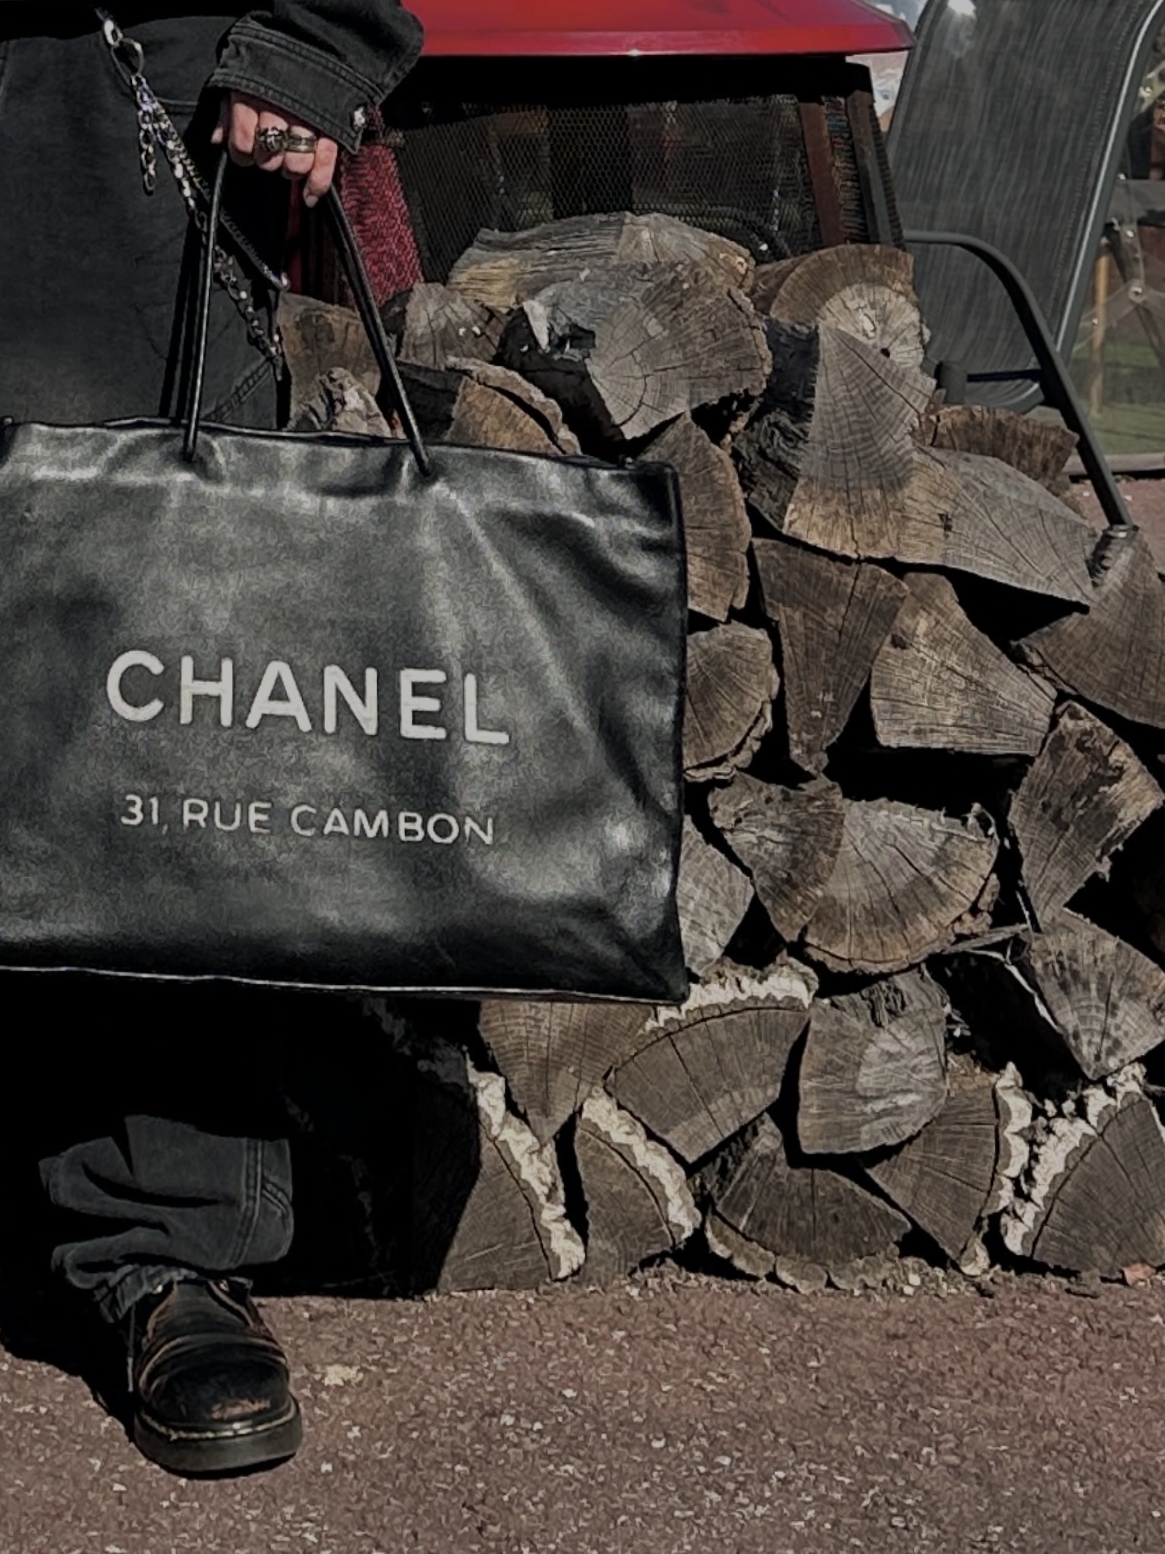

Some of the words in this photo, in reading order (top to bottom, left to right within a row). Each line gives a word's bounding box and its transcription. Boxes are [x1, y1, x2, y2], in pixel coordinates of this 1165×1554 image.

[106, 649, 510, 745] CHANEL
[182, 797, 273, 834] RUE
[290, 804, 494, 845] CAMBON
